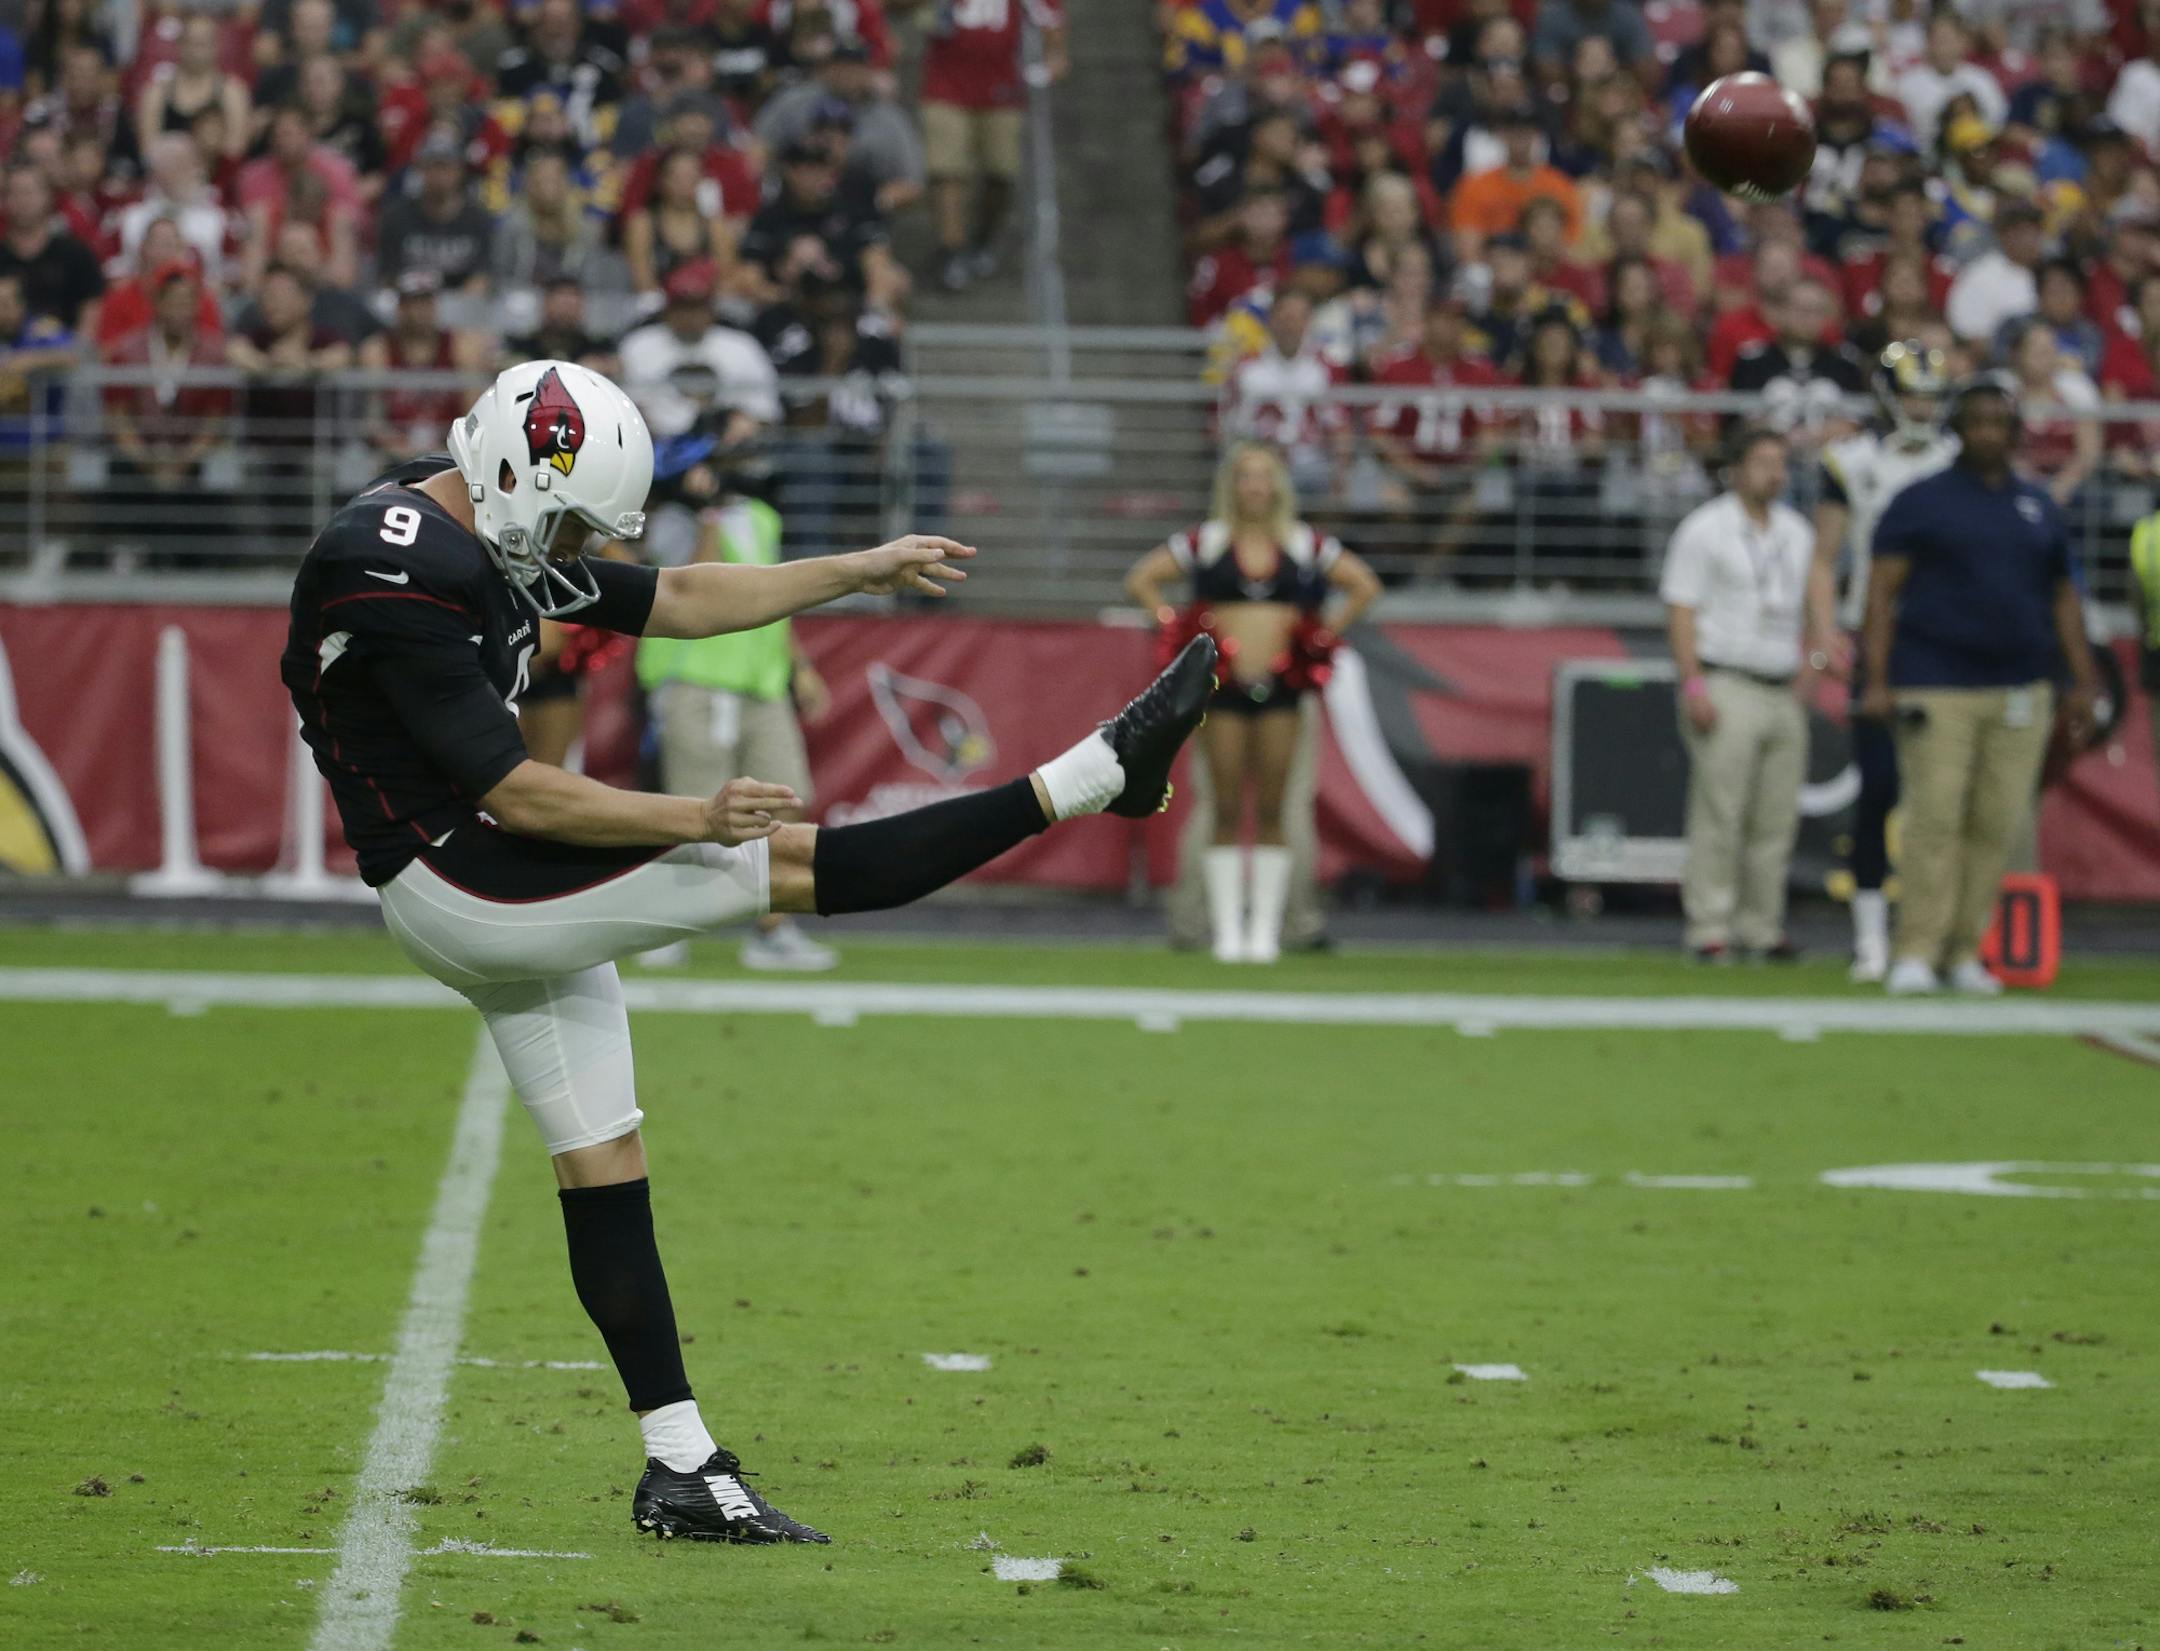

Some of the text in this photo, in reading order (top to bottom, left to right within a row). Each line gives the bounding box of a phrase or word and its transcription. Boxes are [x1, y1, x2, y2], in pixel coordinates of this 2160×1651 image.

[379, 505, 422, 546] 9
[2001, 890, 2041, 969] 0
[703, 1474, 761, 1521] NIKE
